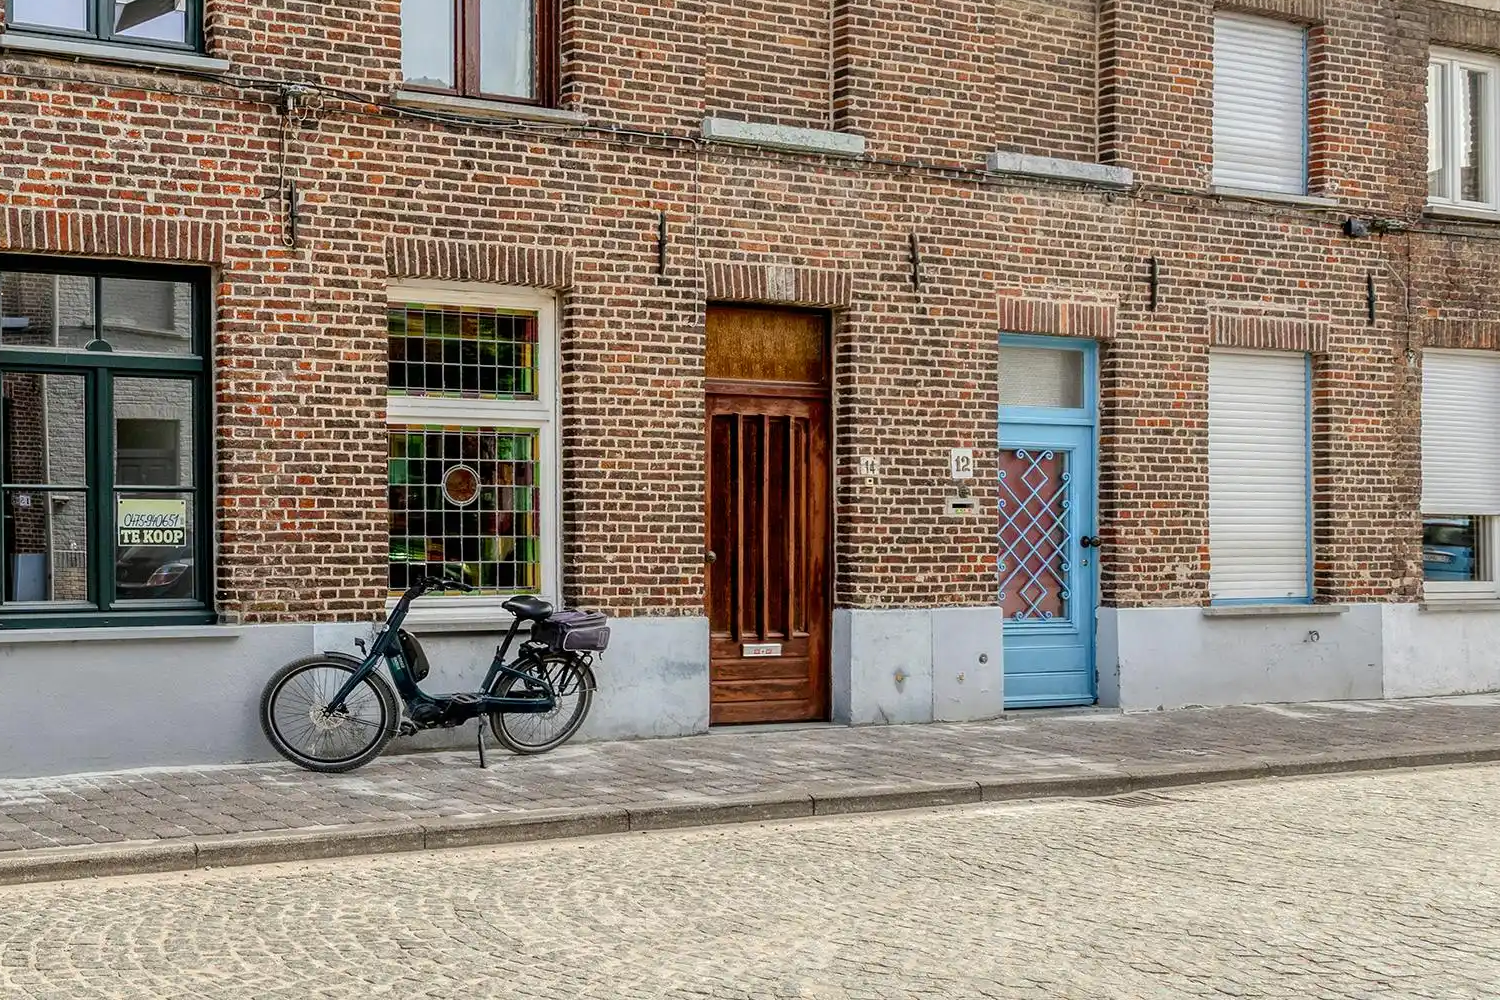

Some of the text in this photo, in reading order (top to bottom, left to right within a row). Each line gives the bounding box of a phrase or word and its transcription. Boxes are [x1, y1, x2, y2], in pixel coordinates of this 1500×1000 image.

[865, 460, 876, 474] 14
[955, 456, 971, 472] 12
[121, 529, 184, 543] TE KOOP
